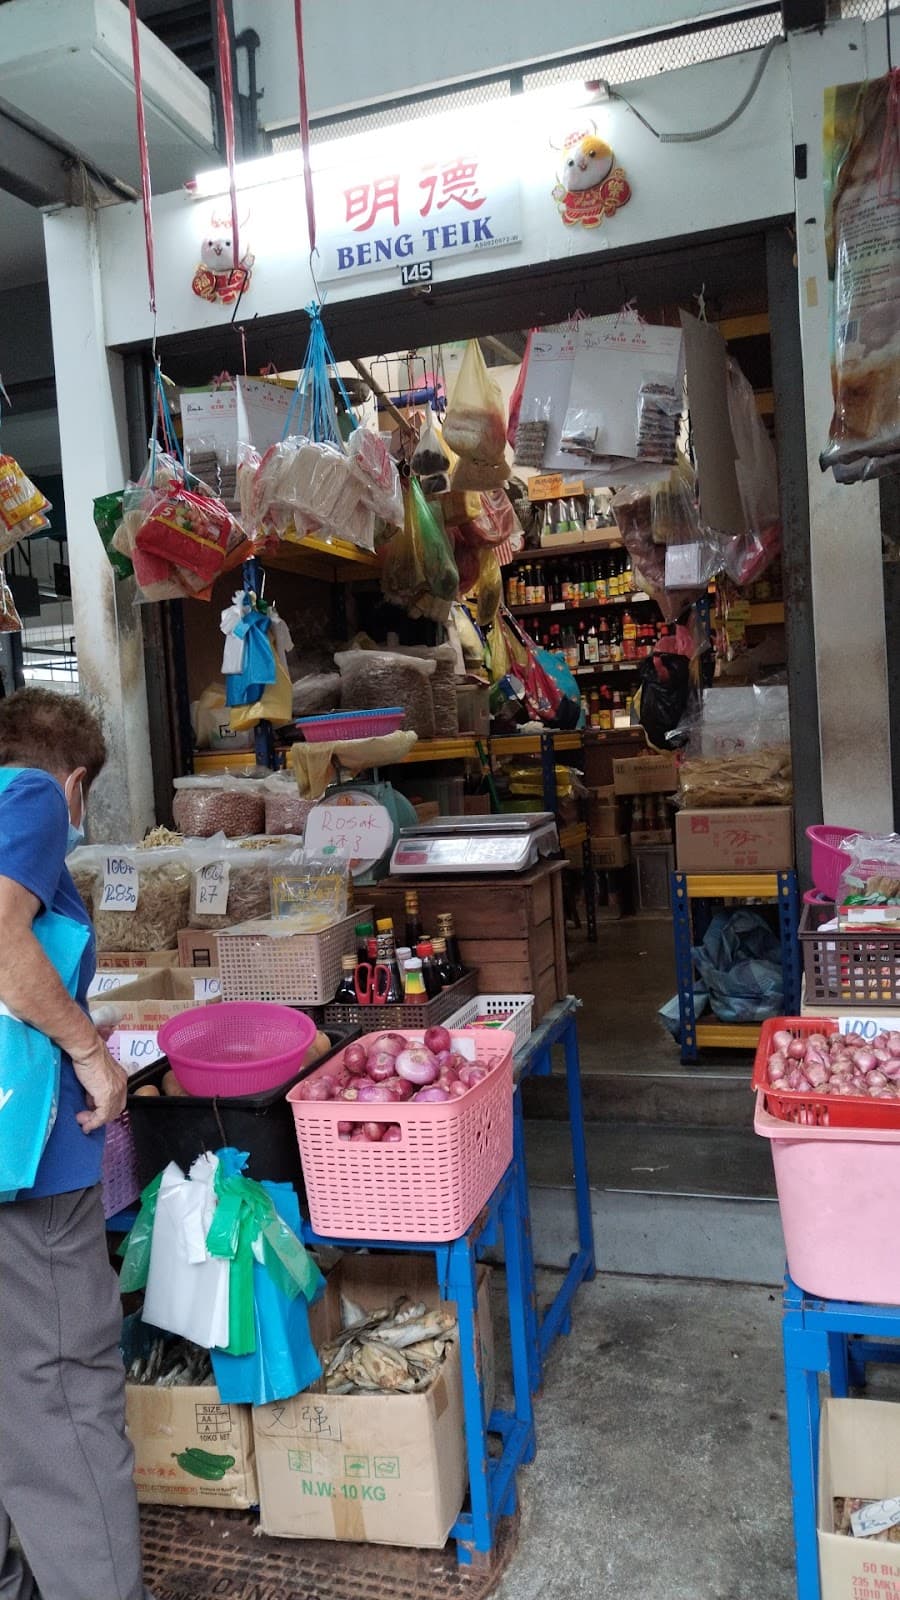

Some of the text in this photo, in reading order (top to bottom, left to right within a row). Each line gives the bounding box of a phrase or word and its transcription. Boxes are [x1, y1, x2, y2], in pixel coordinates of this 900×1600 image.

[344, 157, 487, 232] 明德
[336, 215, 495, 271] BENG TEIK
[402, 262, 432, 284] 145
[302, 1480, 386, 1501] N.W: 10 KG
